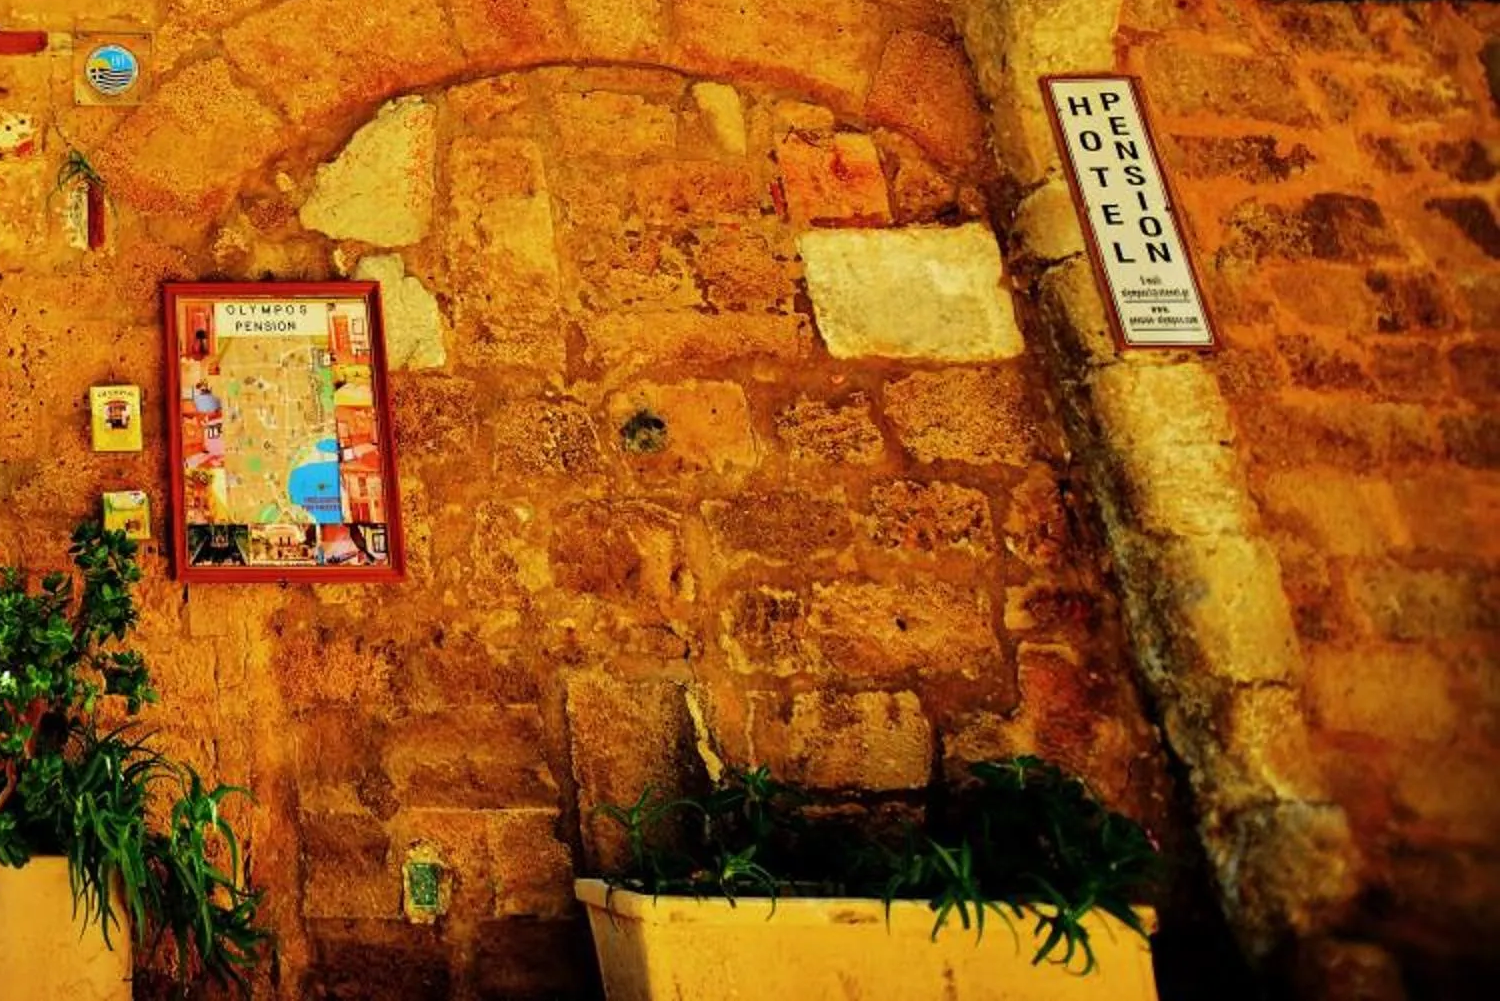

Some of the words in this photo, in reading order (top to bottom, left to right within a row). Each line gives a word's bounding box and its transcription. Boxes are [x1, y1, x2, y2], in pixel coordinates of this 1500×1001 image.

[1067, 96, 1136, 264] HOTEL
[1100, 92, 1173, 264] PENSION
[225, 304, 307, 316] OLYMPOS
[235, 320, 297, 332] PENSION
